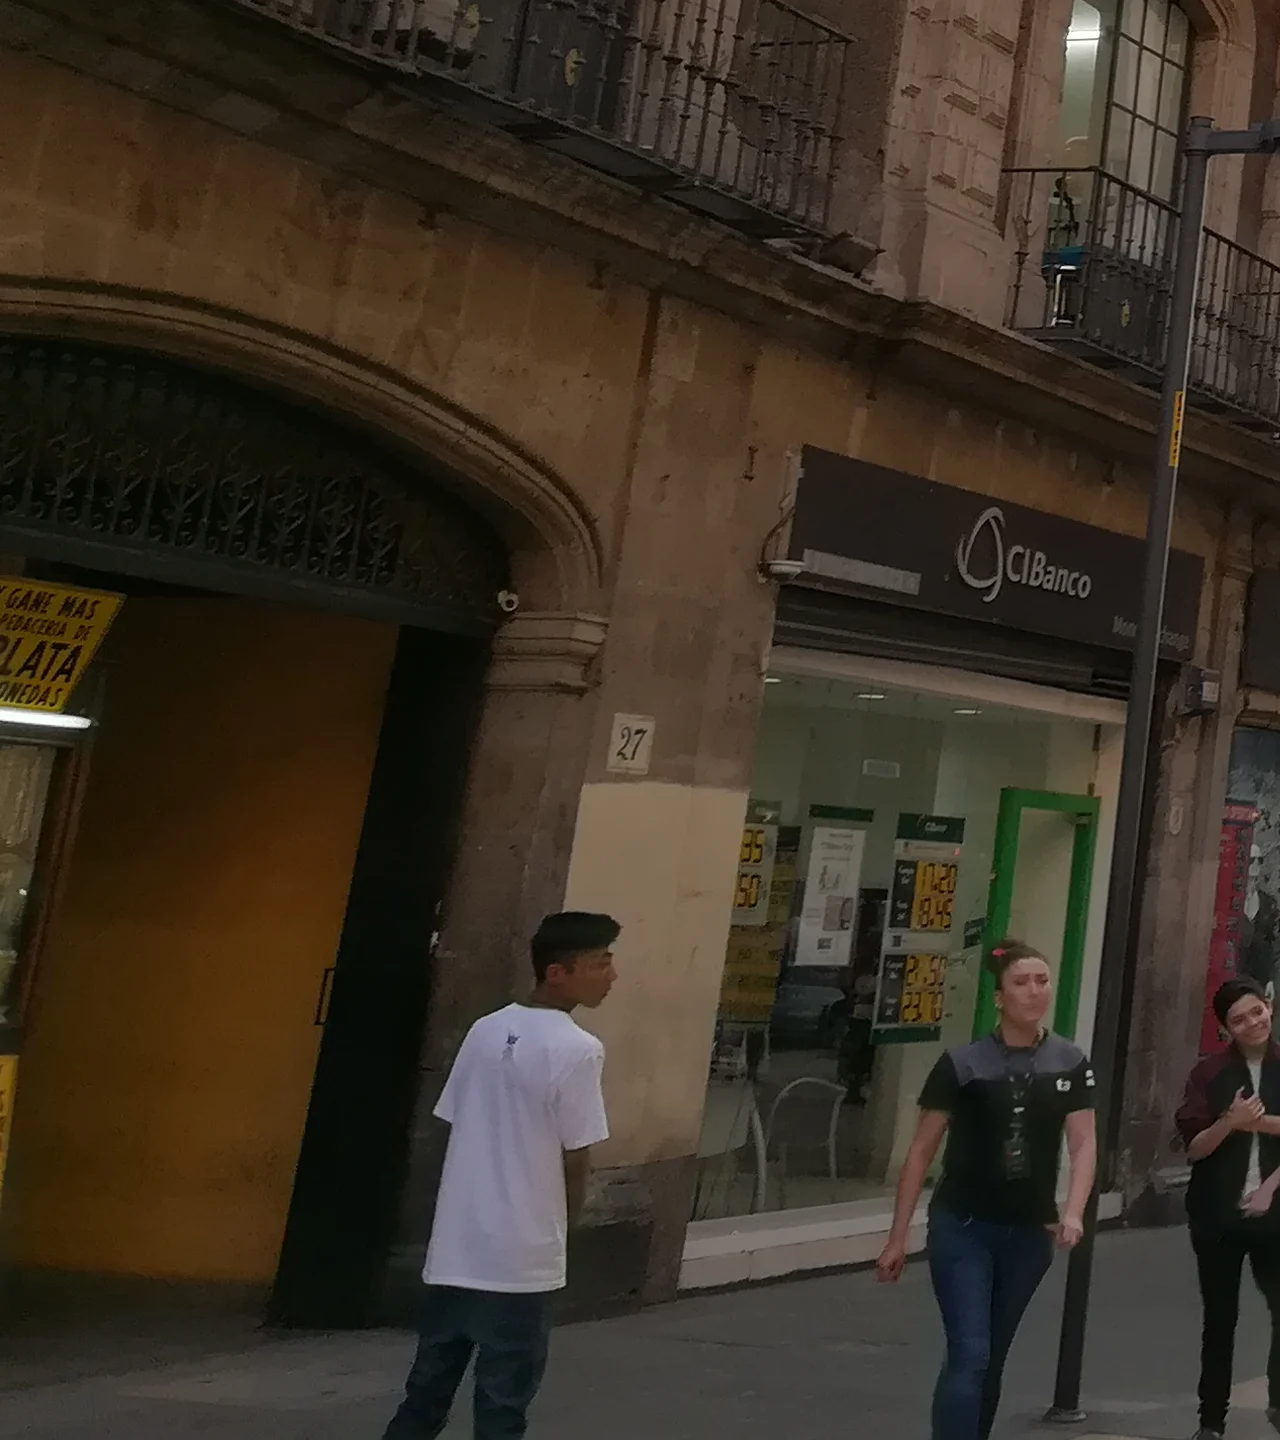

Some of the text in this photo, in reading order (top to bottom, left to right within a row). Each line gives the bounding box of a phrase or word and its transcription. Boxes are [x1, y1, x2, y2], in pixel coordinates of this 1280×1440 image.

[1006, 545, 1092, 599] CIBanco
[5, 588, 55, 613] GANE
[57, 596, 102, 620] MAS
[616, 726, 648, 760] 27
